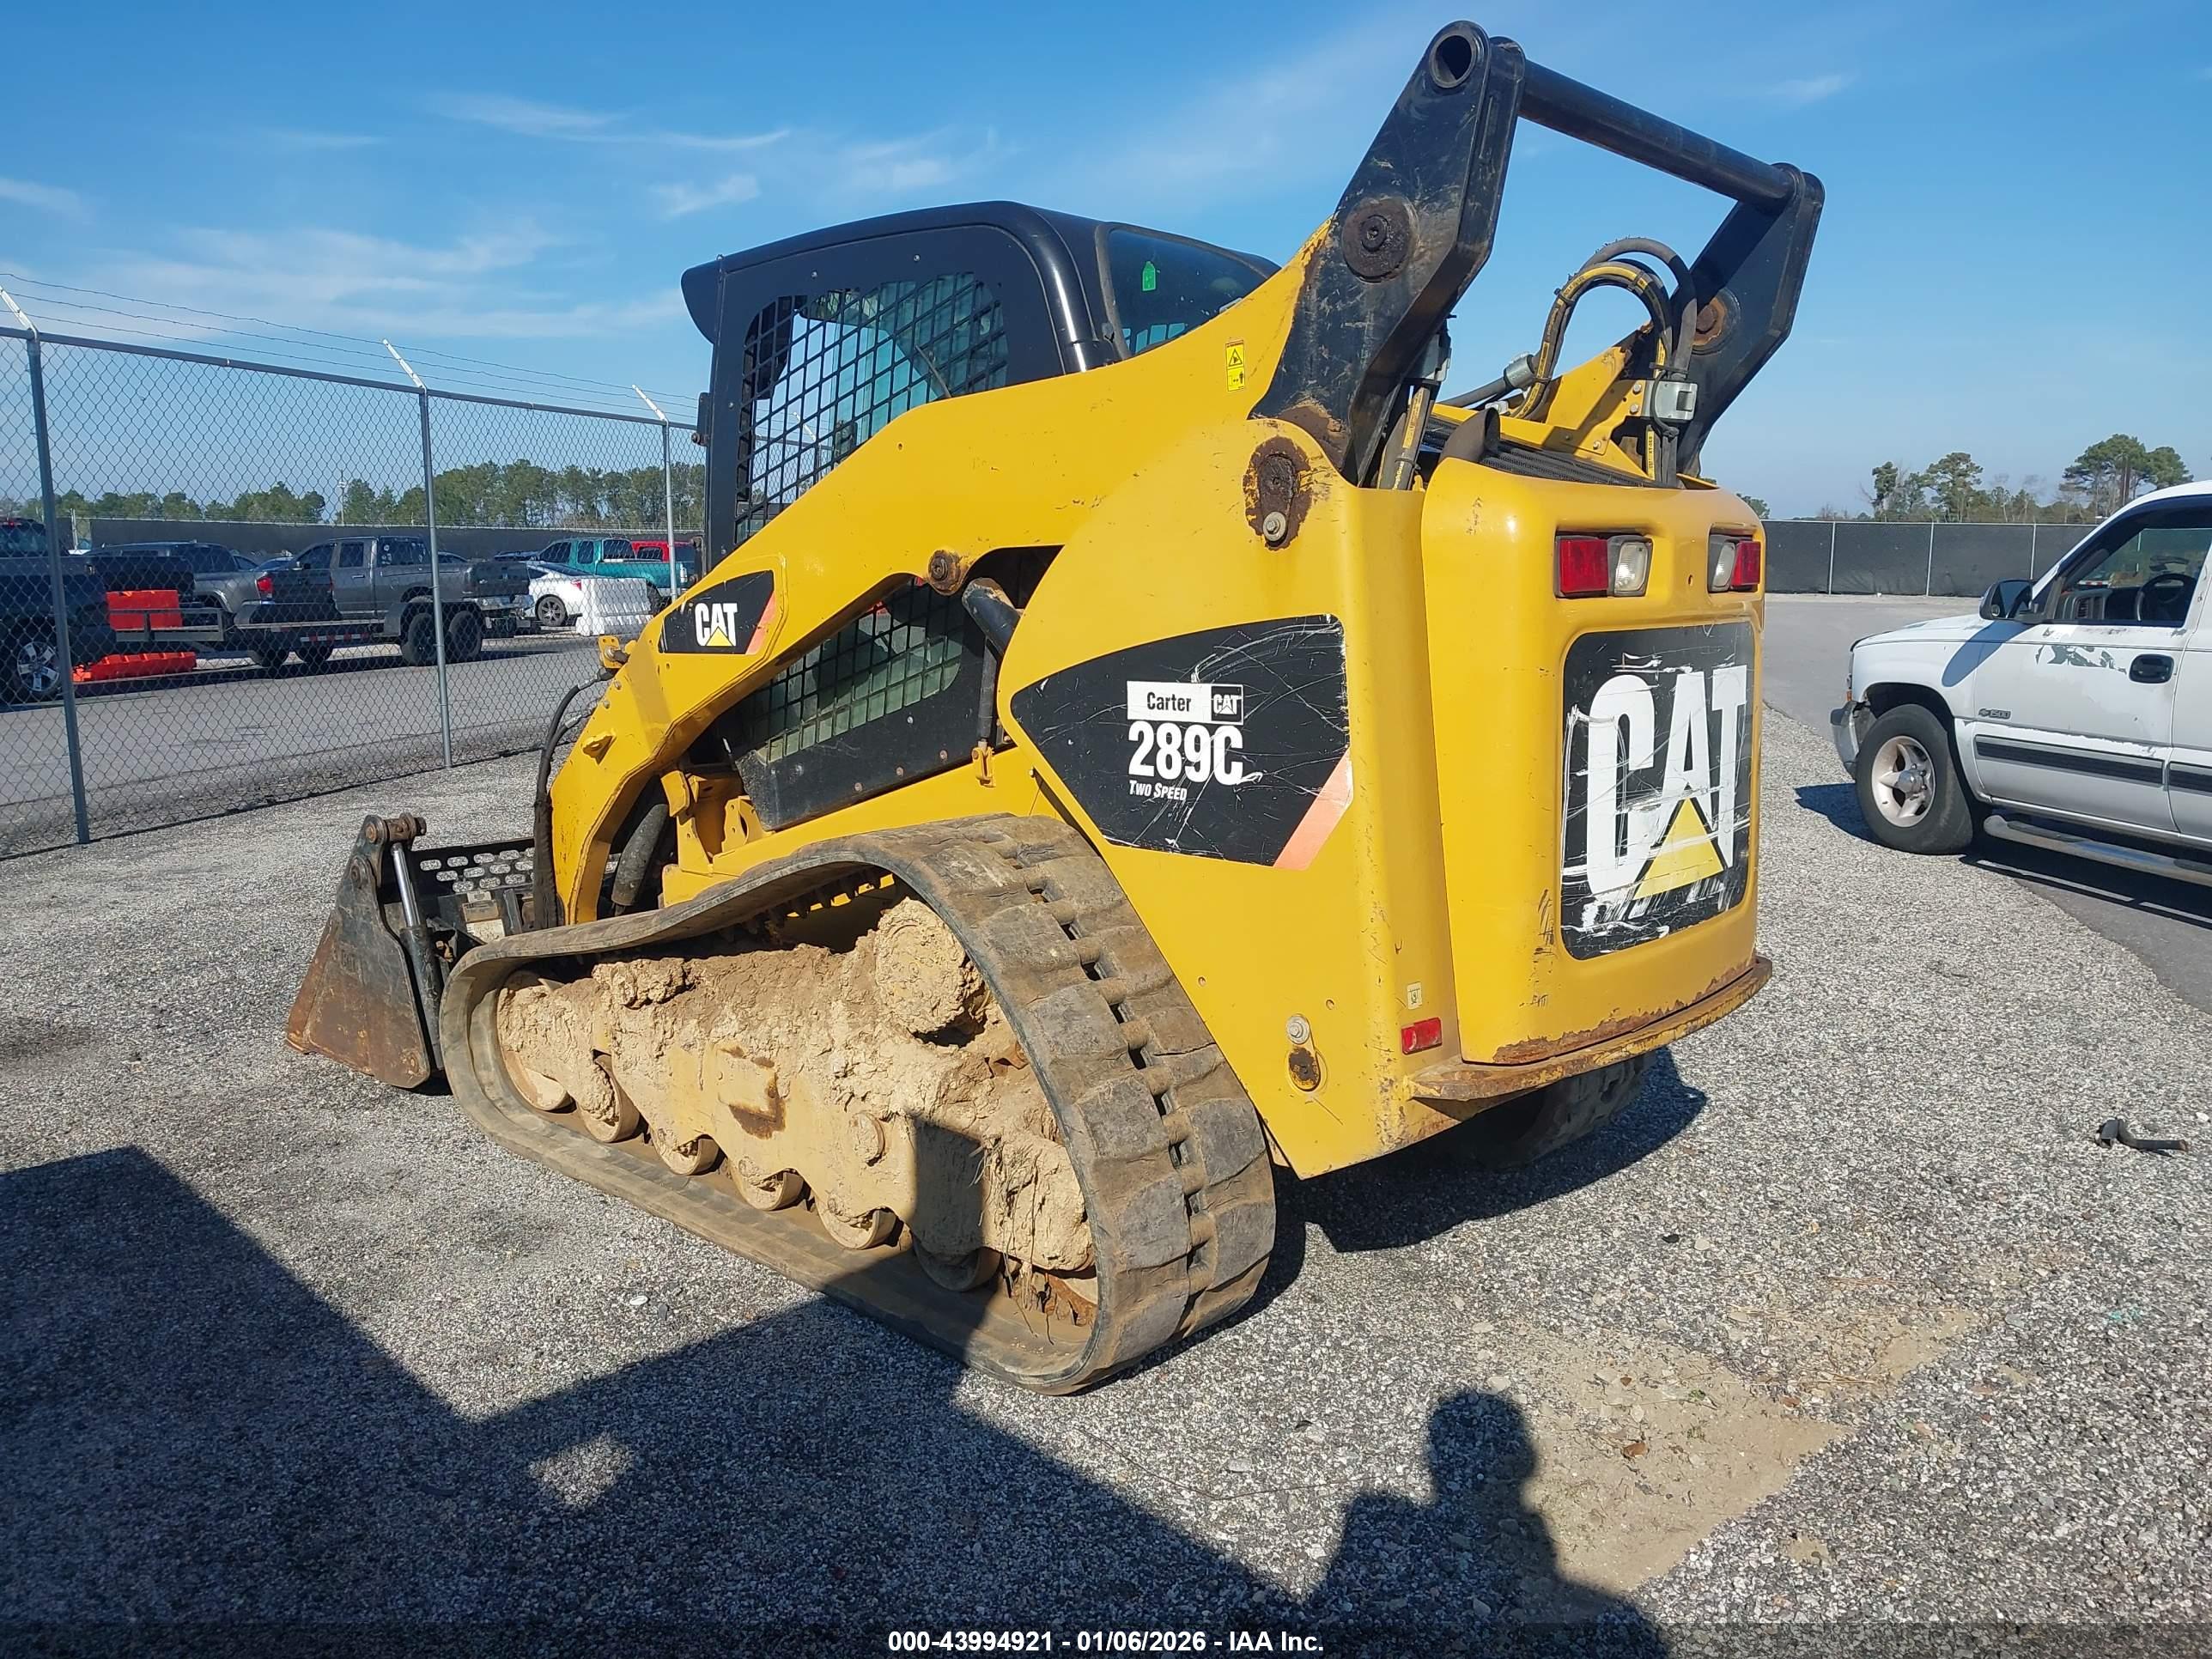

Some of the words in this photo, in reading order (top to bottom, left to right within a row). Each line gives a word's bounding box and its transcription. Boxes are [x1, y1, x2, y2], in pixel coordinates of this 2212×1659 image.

[695, 603, 738, 646] CAT
[1146, 691, 1192, 712] Carter
[1213, 694, 1238, 714] CAT
[1128, 720, 1243, 786] 289C
[1587, 665, 1747, 897] CAT
